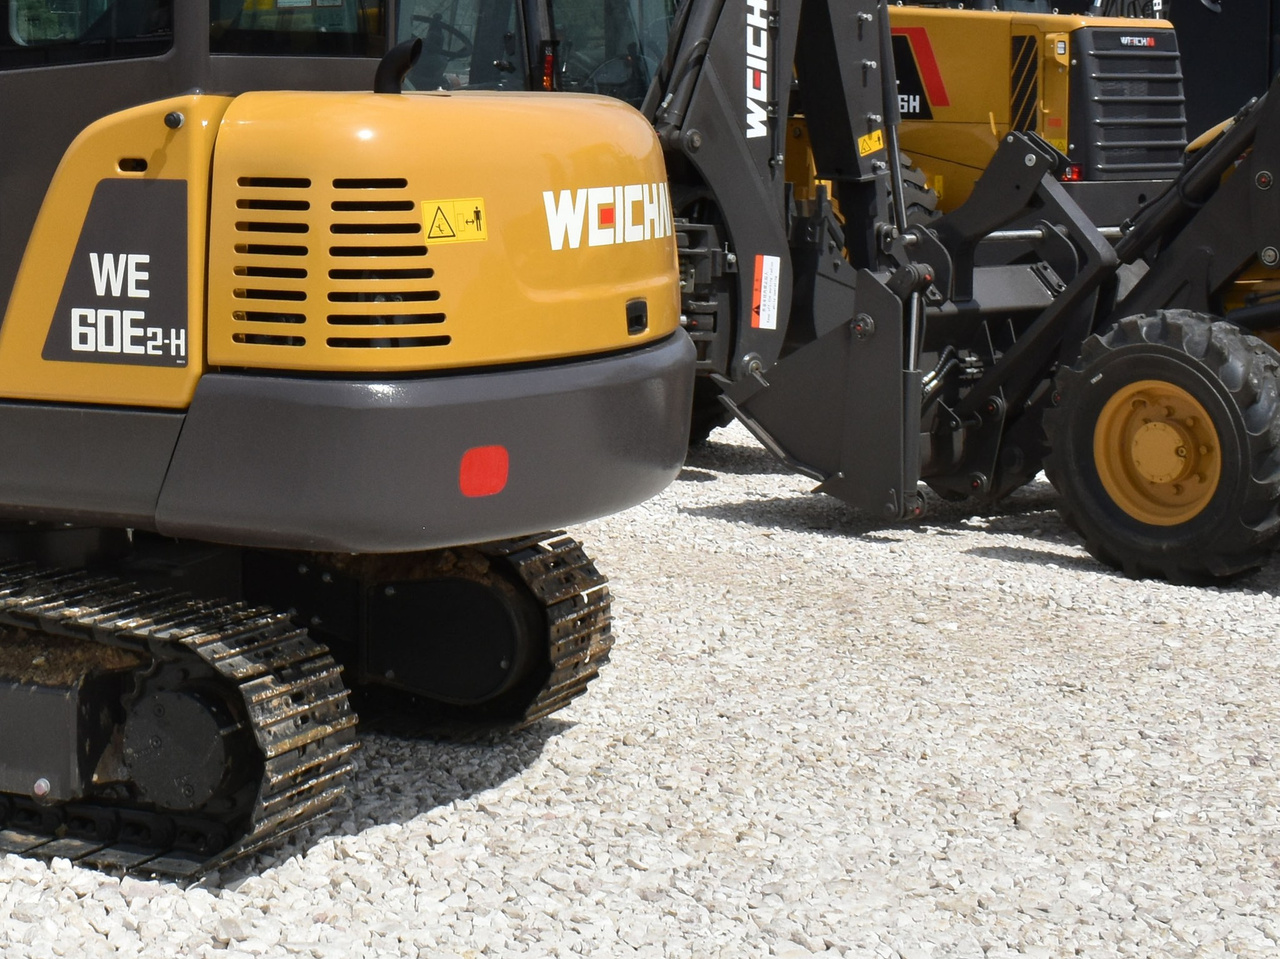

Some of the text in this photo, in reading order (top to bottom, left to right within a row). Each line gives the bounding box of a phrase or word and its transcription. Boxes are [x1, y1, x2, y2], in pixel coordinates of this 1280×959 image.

[898, 94, 920, 113] 6H
[89, 252, 150, 298] WE
[71, 307, 186, 357] 60E2-H
